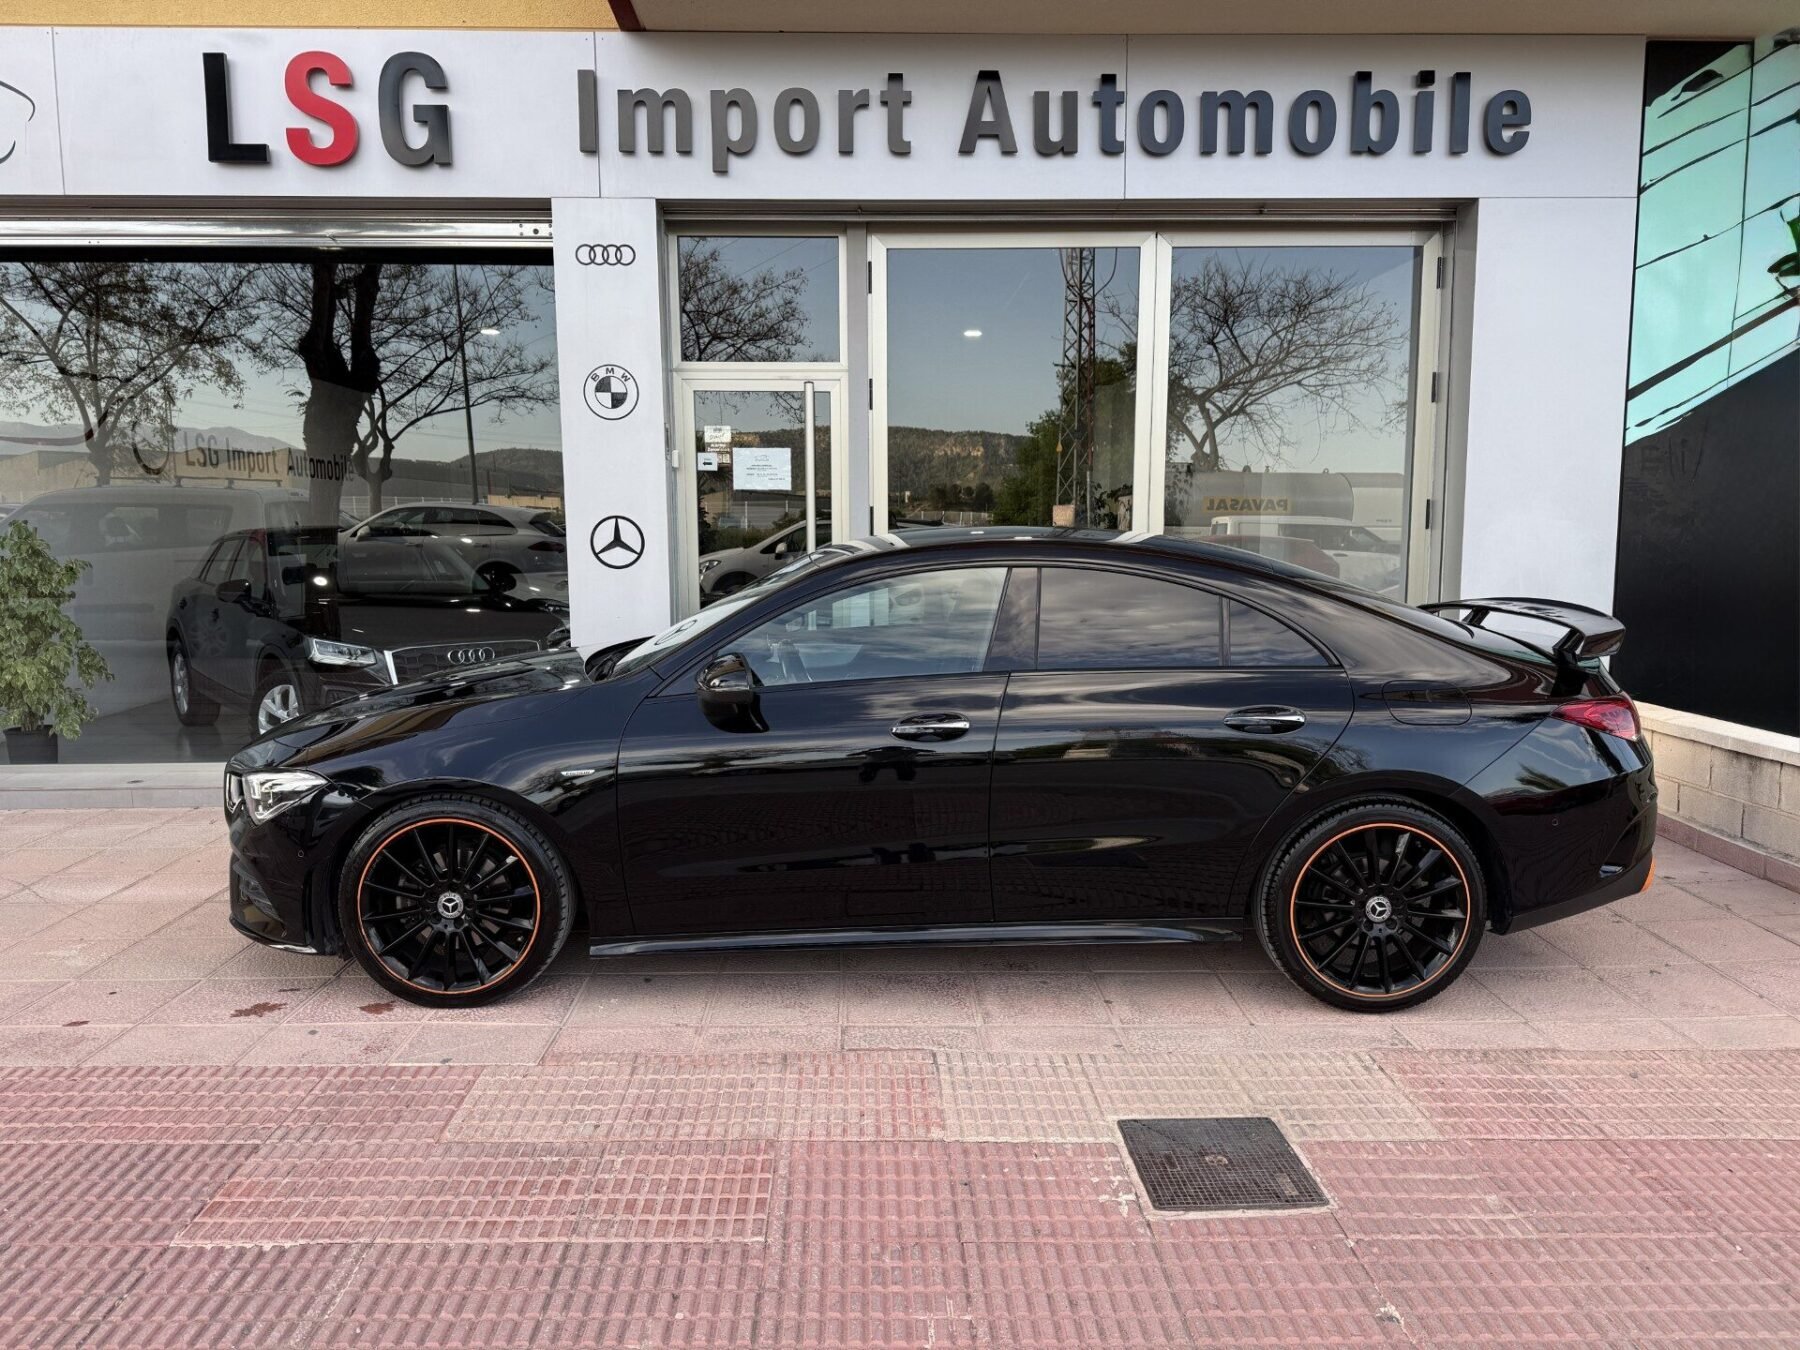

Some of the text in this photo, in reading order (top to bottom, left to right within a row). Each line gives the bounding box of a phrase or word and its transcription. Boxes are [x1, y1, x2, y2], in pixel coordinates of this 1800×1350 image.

[202, 50, 1532, 173] LSG Import Automobile
[590, 367, 631, 382] BMW
[184, 431, 354, 482] LSG Import Automobile
